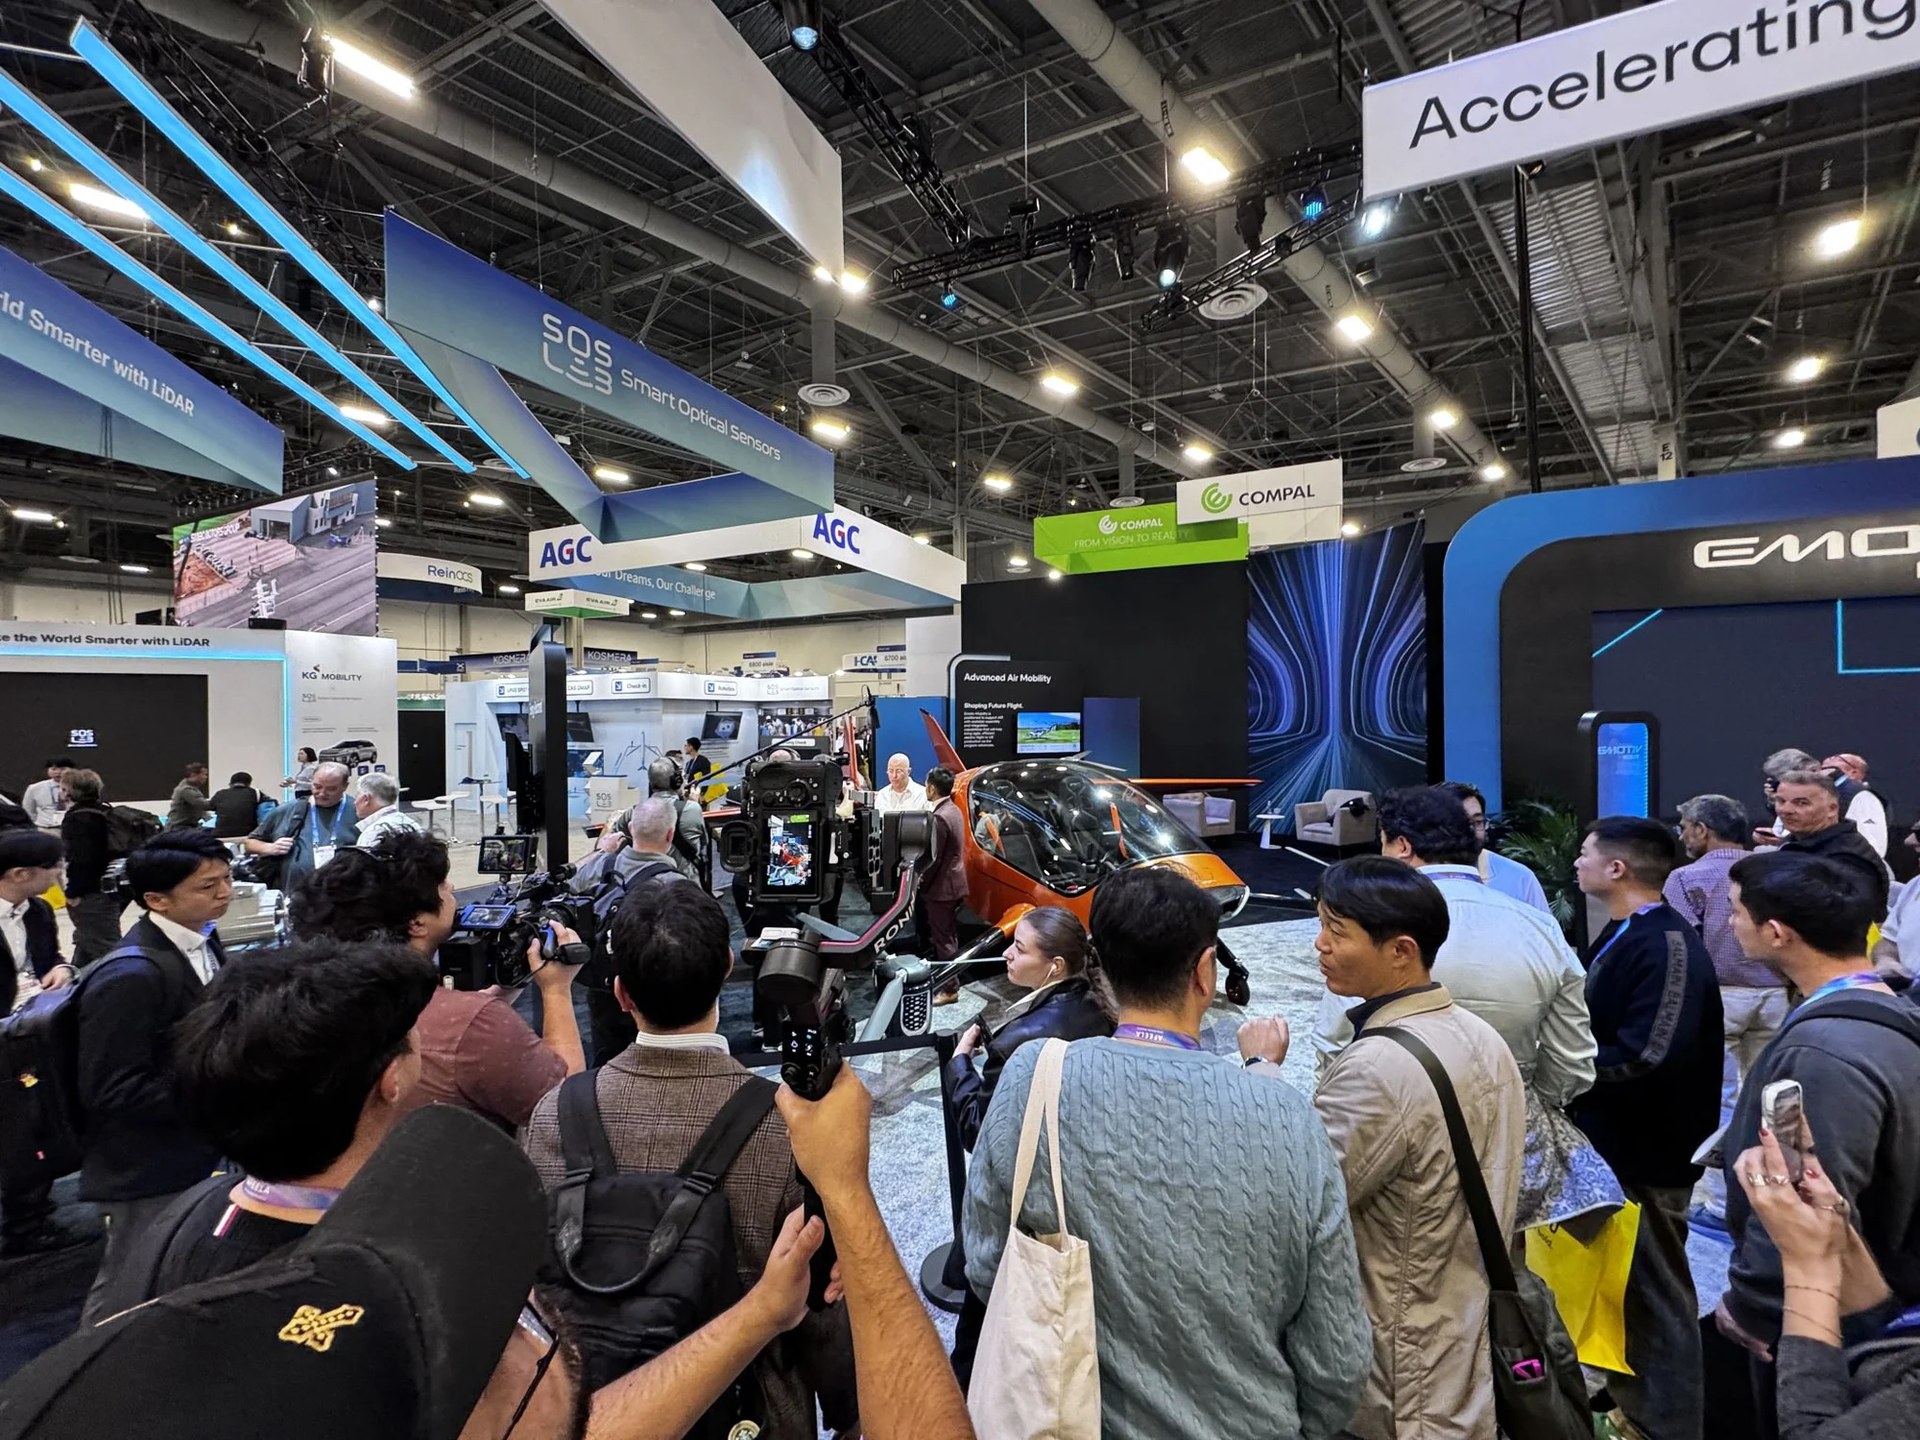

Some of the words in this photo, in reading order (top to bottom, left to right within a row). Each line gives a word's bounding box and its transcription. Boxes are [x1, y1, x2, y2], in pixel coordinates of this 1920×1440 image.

[1409, 0, 1917, 148] Accelerating
[542, 313, 613, 368] SOS
[28, 308, 110, 368] Smarter
[113, 358, 149, 391] with
[152, 378, 194, 417] LiDAR
[620, 368, 676, 410] Smart
[678, 398, 729, 436] Optical
[730, 424, 781, 461] Sensors
[1239, 484, 1316, 506] COMPAL
[813, 512, 860, 555] AGC
[1120, 518, 1164, 531] COMPAL
[1074, 539, 1100, 549] FROM
[1102, 535, 1134, 545] VISION
[1136, 533, 1149, 543] TO
[1151, 529, 1189, 540] REALTY
[540, 535, 592, 568] AGC
[615, 570, 655, 589] Dreams,
[656, 578, 673, 591] Our
[675, 582, 716, 600] Challenge
[14, 634, 38, 642] the
[40, 634, 82, 644] World
[85, 635, 139, 645] Smarter
[141, 636, 170, 646] with
[172, 637, 210, 647] LiDAR
[587, 651, 632, 662] KOSMERA
[301, 672, 317, 680] KG
[321, 673, 362, 681] MOBILITY
[964, 673, 1006, 682] Advanced
[1007, 673, 1019, 682] Air
[1020, 674, 1051, 684] Mobility
[963, 702, 988, 710] Shaping
[70, 729, 95, 737] SOS
[874, 890, 915, 955] RONIN
[1135, 1030, 1164, 1042] AFEELA
